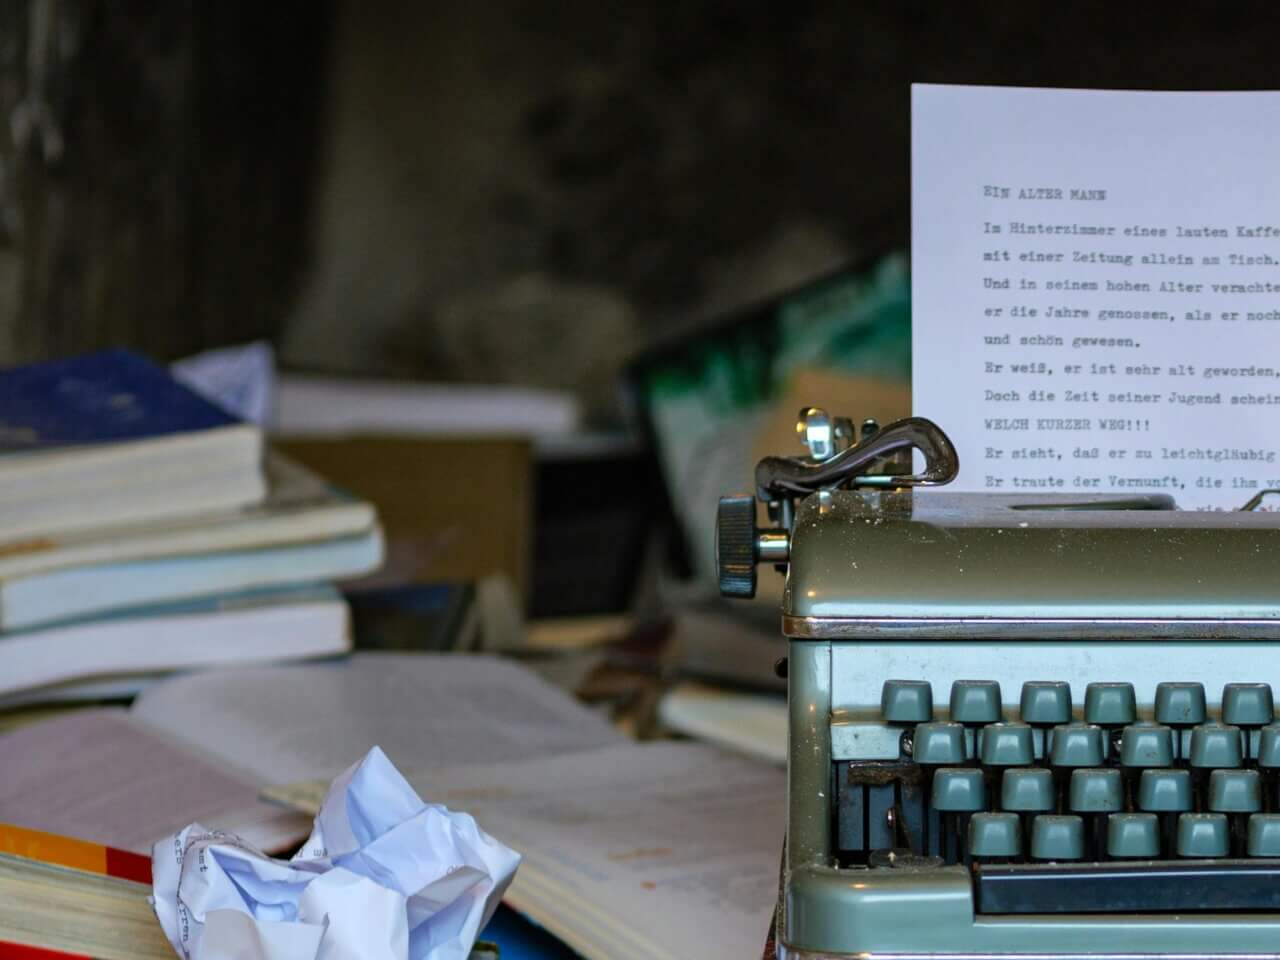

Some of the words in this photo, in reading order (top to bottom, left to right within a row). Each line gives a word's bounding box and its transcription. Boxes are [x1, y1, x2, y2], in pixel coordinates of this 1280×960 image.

[983, 185, 1010, 199] EIN
[1018, 188, 1063, 200] ALTER
[1070, 189, 1107, 201] MANN
[983, 222, 1002, 235] Im
[1009, 222, 1117, 235] Hinterzimmer
[1123, 225, 1168, 237] eines
[1175, 226, 1229, 238] lauten
[982, 250, 1011, 262] mit
[1018, 251, 1065, 262] einer
[1072, 251, 1135, 266] Zeitung
[1140, 253, 1195, 265] allein
[1201, 256, 1221, 266] am
[1227, 254, 1280, 266] Tisch.
[983, 277, 1011, 289] Und
[1019, 278, 1038, 290] in
[1045, 280, 1099, 290] seinem
[1105, 280, 1151, 292] hohen
[1159, 281, 1204, 293] Alter
[984, 308, 1003, 317] er
[1010, 306, 1038, 317] die
[1045, 306, 1091, 318] Jahre
[1097, 309, 1175, 323] genossen,
[1184, 309, 1212, 320] als
[1220, 312, 1239, 321] er
[983, 334, 1011, 345] und
[1019, 334, 1064, 346] schön
[1071, 337, 1141, 350] gewesen.
[984, 362, 1004, 373] Er
[1009, 363, 1054, 376] weiß,
[1063, 365, 1083, 374] er
[1090, 363, 1117, 374] ist
[1124, 364, 1162, 375] sehr
[1168, 365, 1196, 376] alt
[1202, 365, 1280, 378] geworden,
[984, 390, 1021, 402] Doch
[1027, 390, 1056, 402] die
[1064, 390, 1100, 402] Zeit
[1107, 392, 1162, 403] seiner
[1167, 392, 1222, 406] Jugend
[984, 418, 1030, 430] WELCH
[1036, 419, 1091, 430] KURZER
[1098, 419, 1150, 431] WEG!!!
[985, 447, 1004, 459] Er
[1011, 448, 1063, 461] sieht,
[1072, 447, 1100, 459] daß
[1108, 450, 1127, 459] er
[1135, 450, 1153, 459] zu
[1161, 448, 1276, 463] leichtgläubig
[985, 475, 1004, 488] Er
[1012, 475, 1065, 488] traute
[1072, 475, 1102, 488] der
[1109, 475, 1186, 491] Vernunft,
[1195, 476, 1223, 489] die
[1231, 476, 1259, 489] ihm
